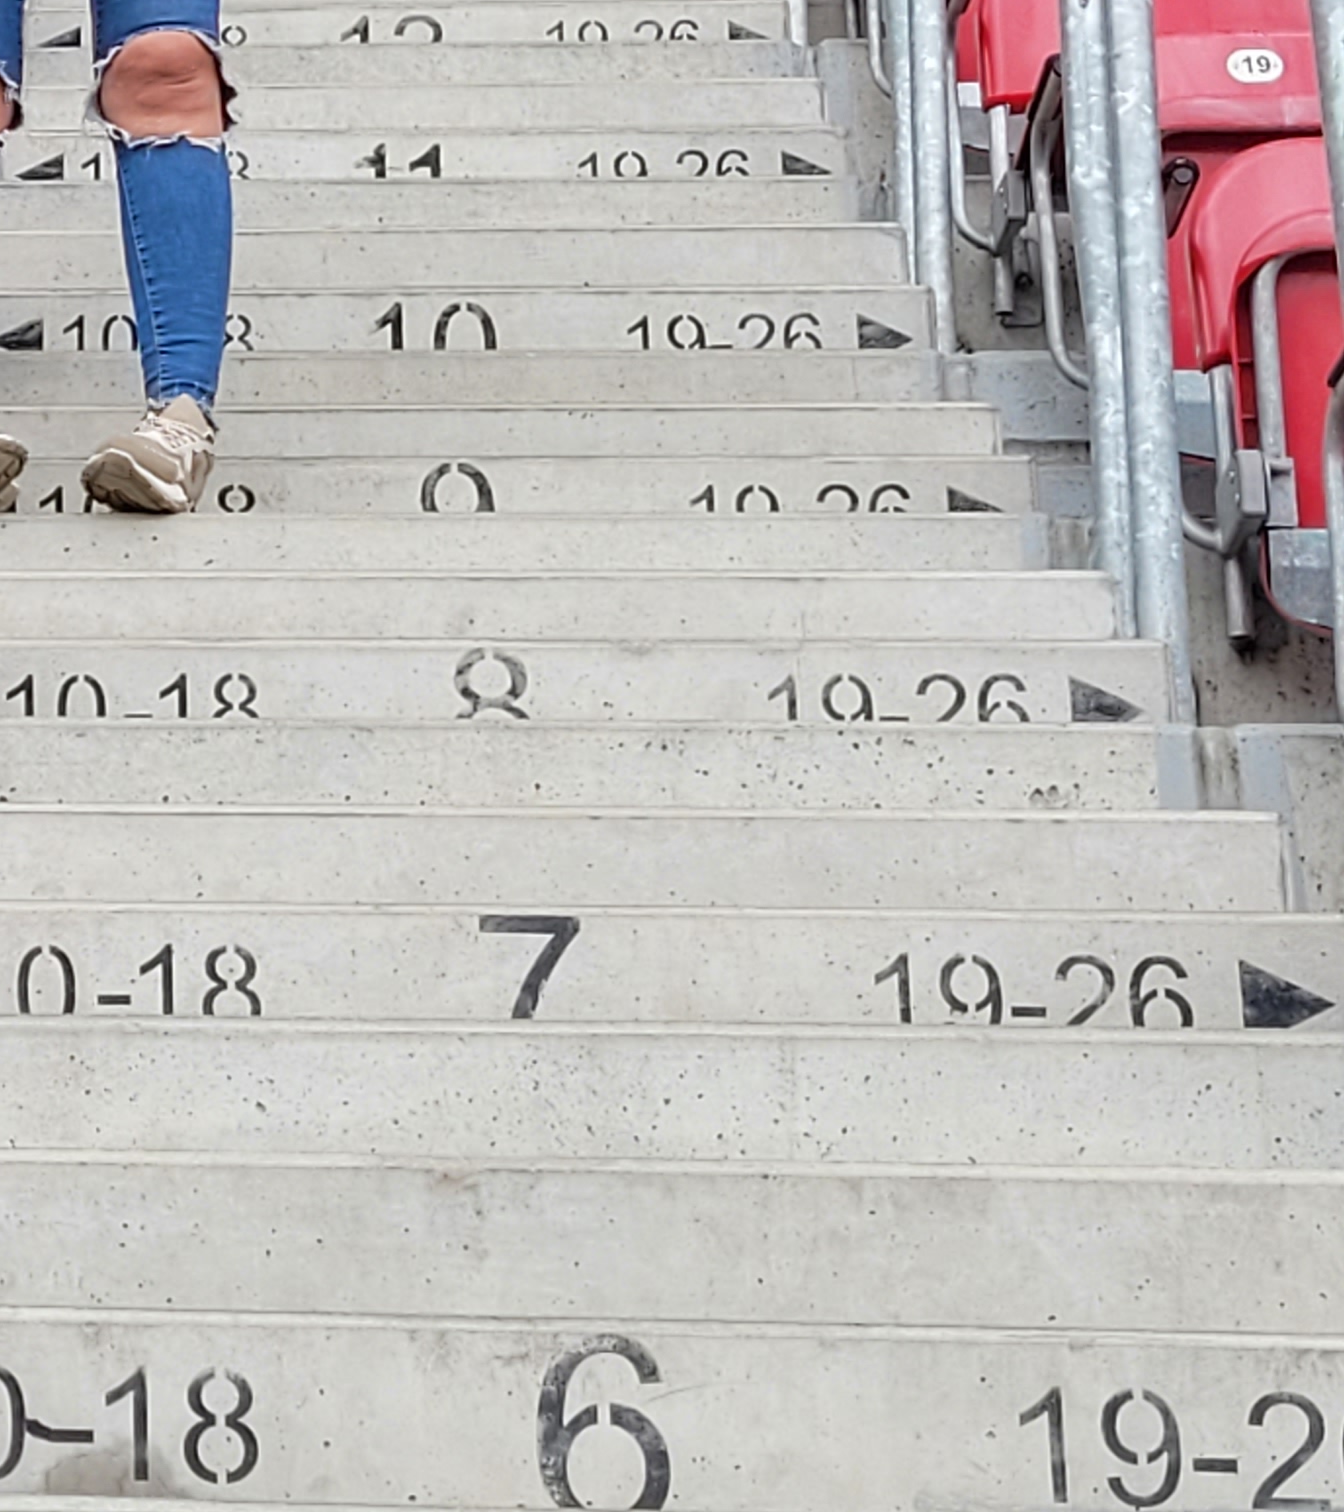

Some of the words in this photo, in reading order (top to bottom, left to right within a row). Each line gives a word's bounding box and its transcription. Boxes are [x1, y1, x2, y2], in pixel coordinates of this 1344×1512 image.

[1242, 55, 1271, 74] 19
[478, 915, 581, 1019] 7
[873, 953, 1195, 1028] 19-26
[536, 1333, 672, 1510] 6
[1019, 1386, 1344, 1510] 19-2
